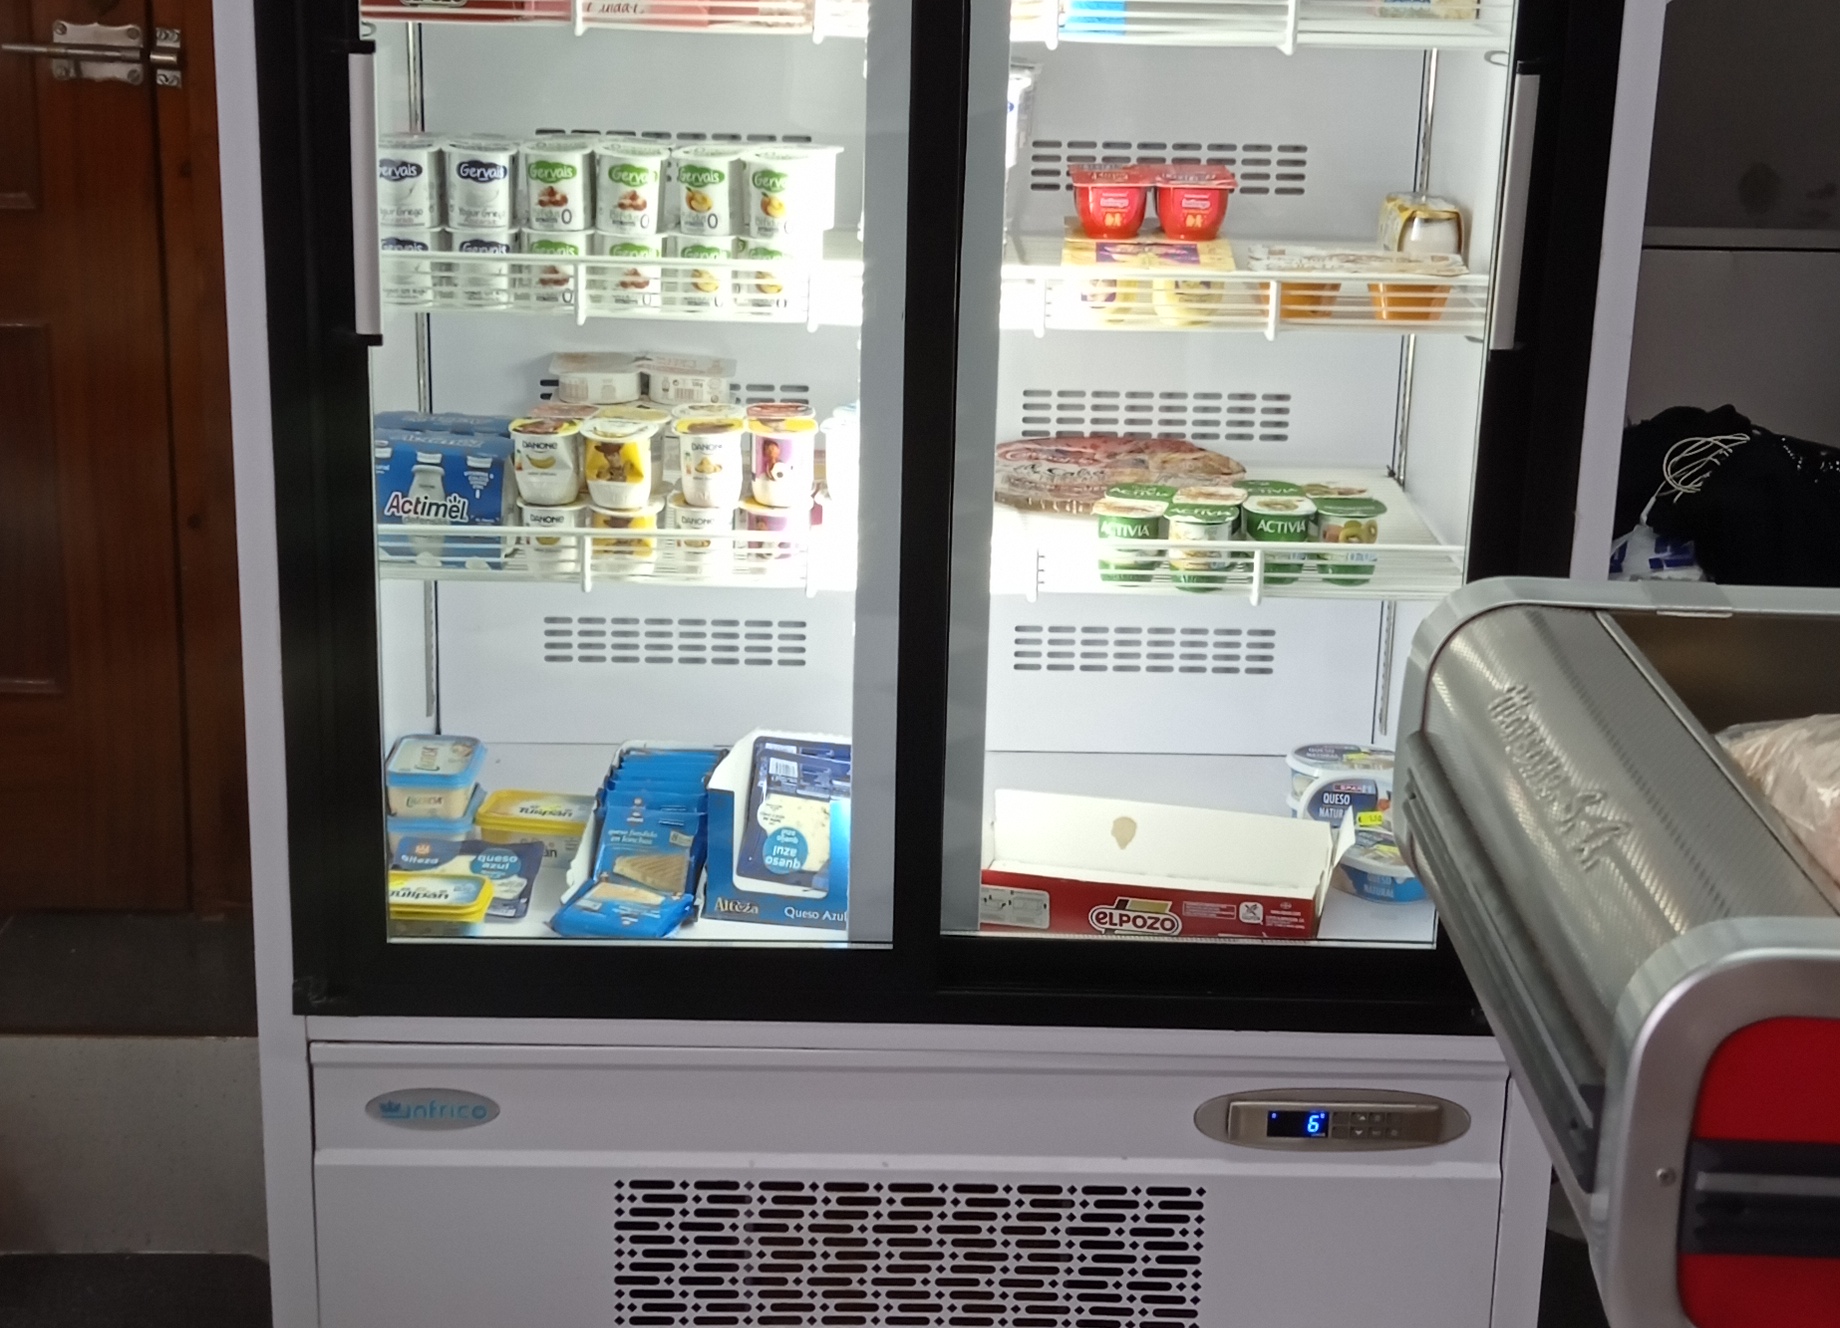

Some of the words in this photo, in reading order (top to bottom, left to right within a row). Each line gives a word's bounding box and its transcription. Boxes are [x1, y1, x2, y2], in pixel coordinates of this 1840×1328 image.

[460, 162, 504, 181] Gervais
[530, 163, 573, 180] Gervais
[385, 493, 468, 522] Actimel
[1257, 520, 1306, 533] ACTIVIA
[1323, 793, 1350, 805] QUESO
[1319, 807, 1344, 819] NATUR
[772, 845, 797, 856] azul
[477, 855, 518, 866] queso
[481, 863, 509, 871] azul
[765, 856, 801, 870] queso
[784, 906, 819, 920] Queso
[1307, 1114, 1320, 1133] 6
